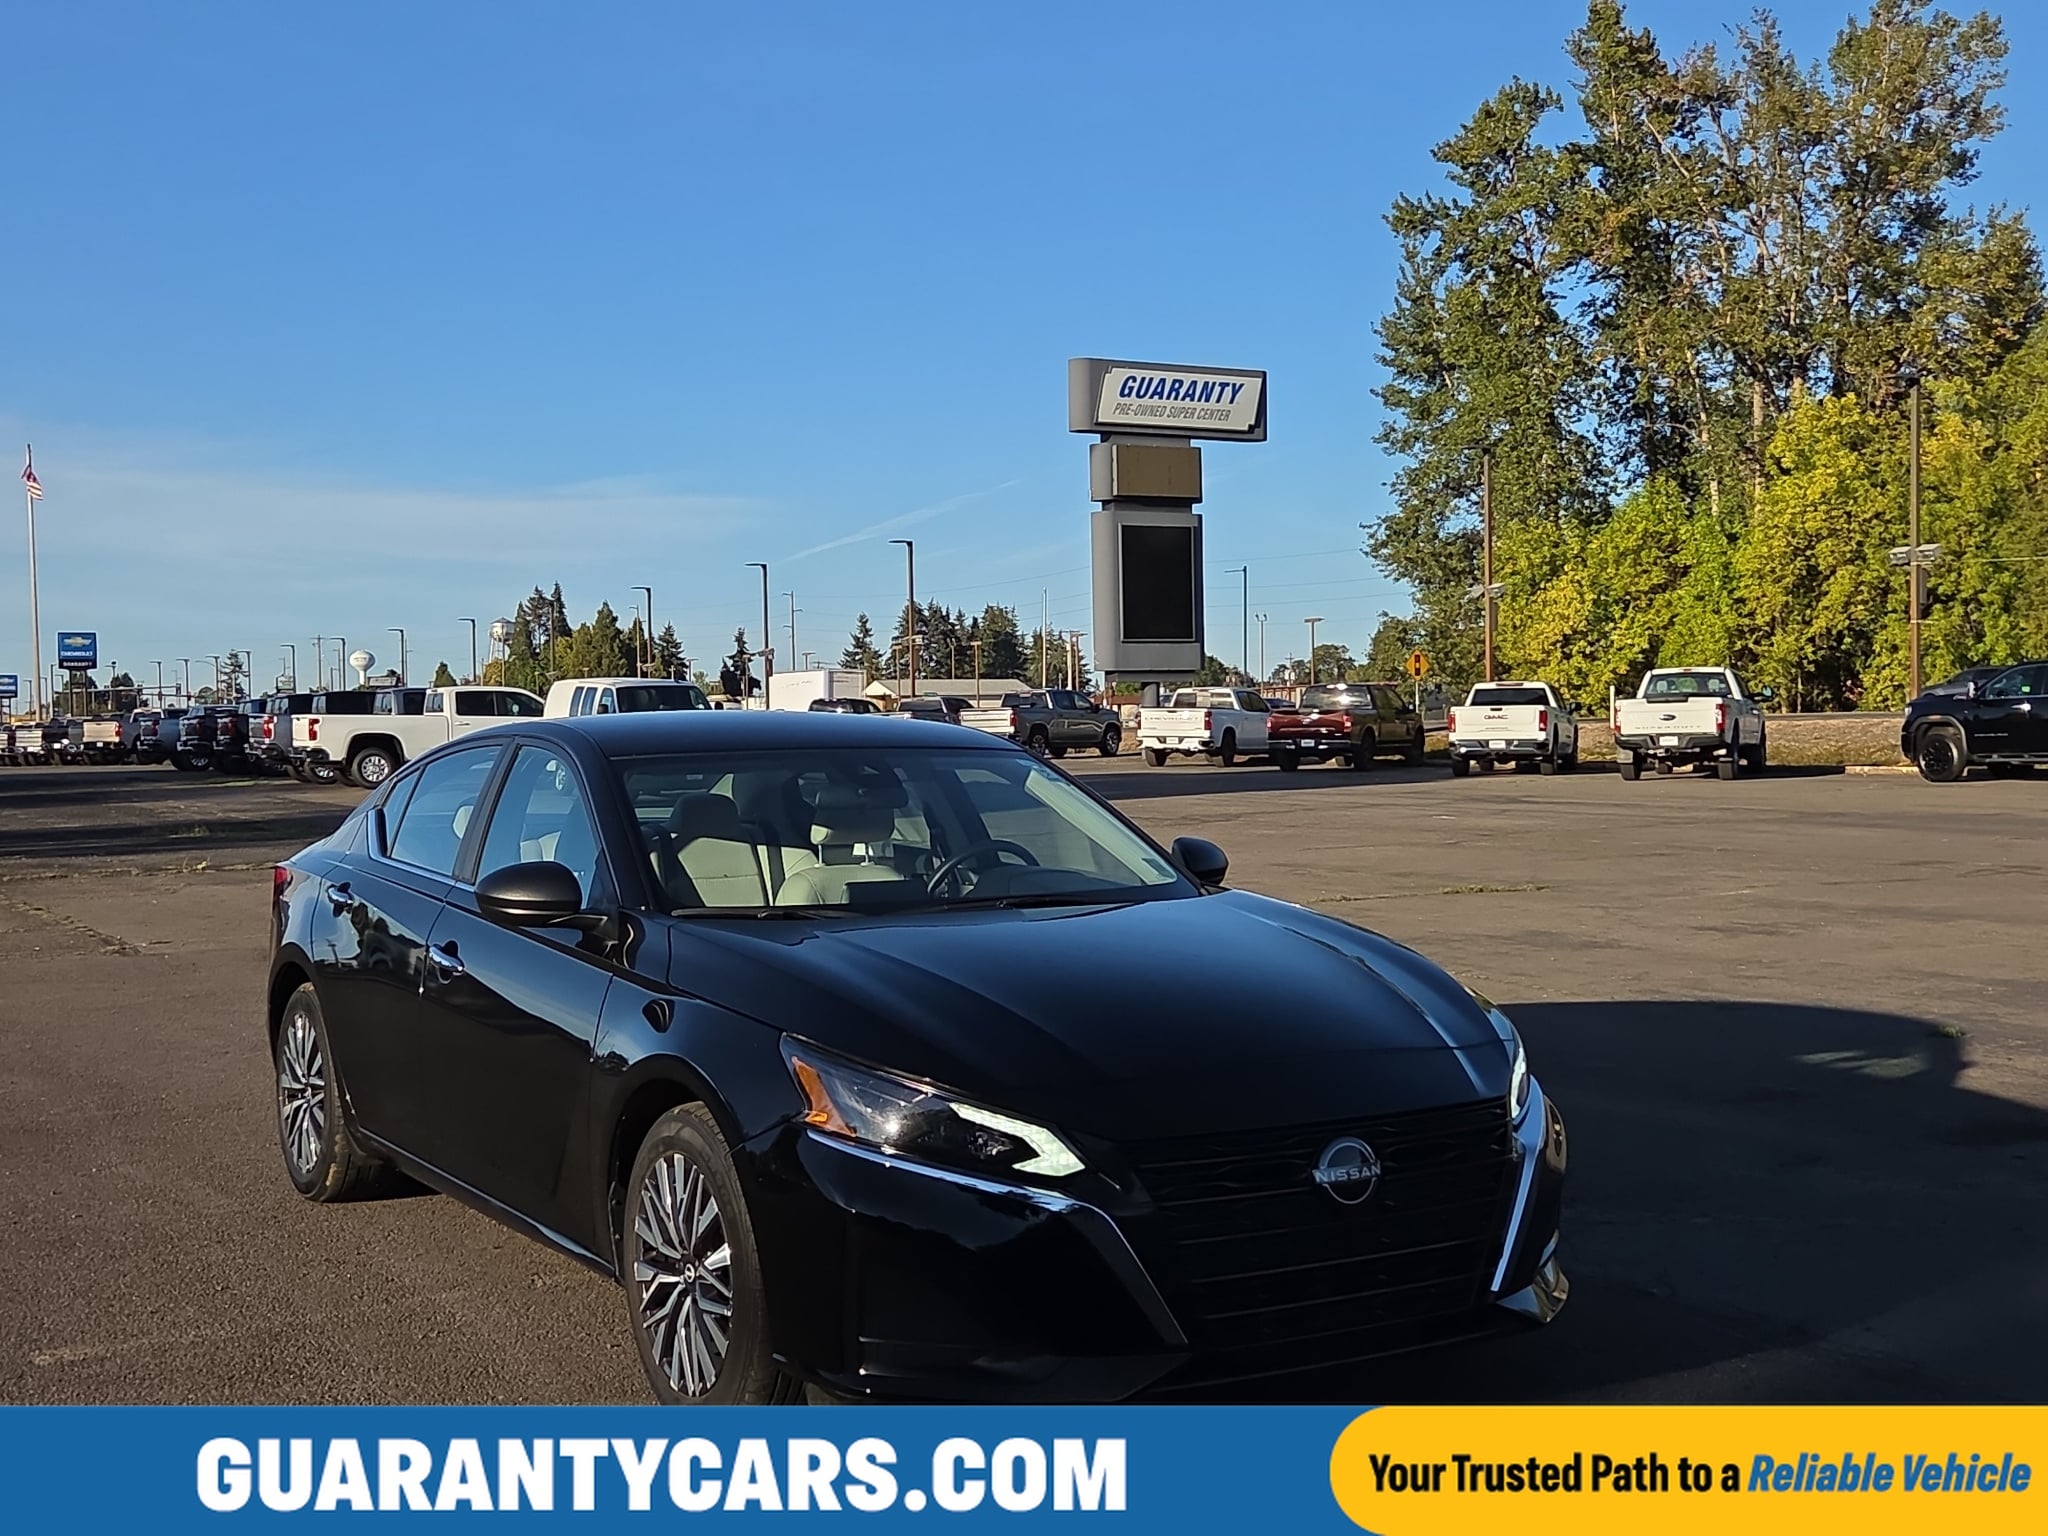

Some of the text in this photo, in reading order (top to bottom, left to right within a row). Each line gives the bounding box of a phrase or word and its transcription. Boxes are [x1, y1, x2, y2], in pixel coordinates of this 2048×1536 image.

[1118, 375, 1245, 405] GUARANTY
[1113, 402, 1231, 421] PRE-OWNED SUPER CENTER
[1312, 1160, 1381, 1183] NISSAN
